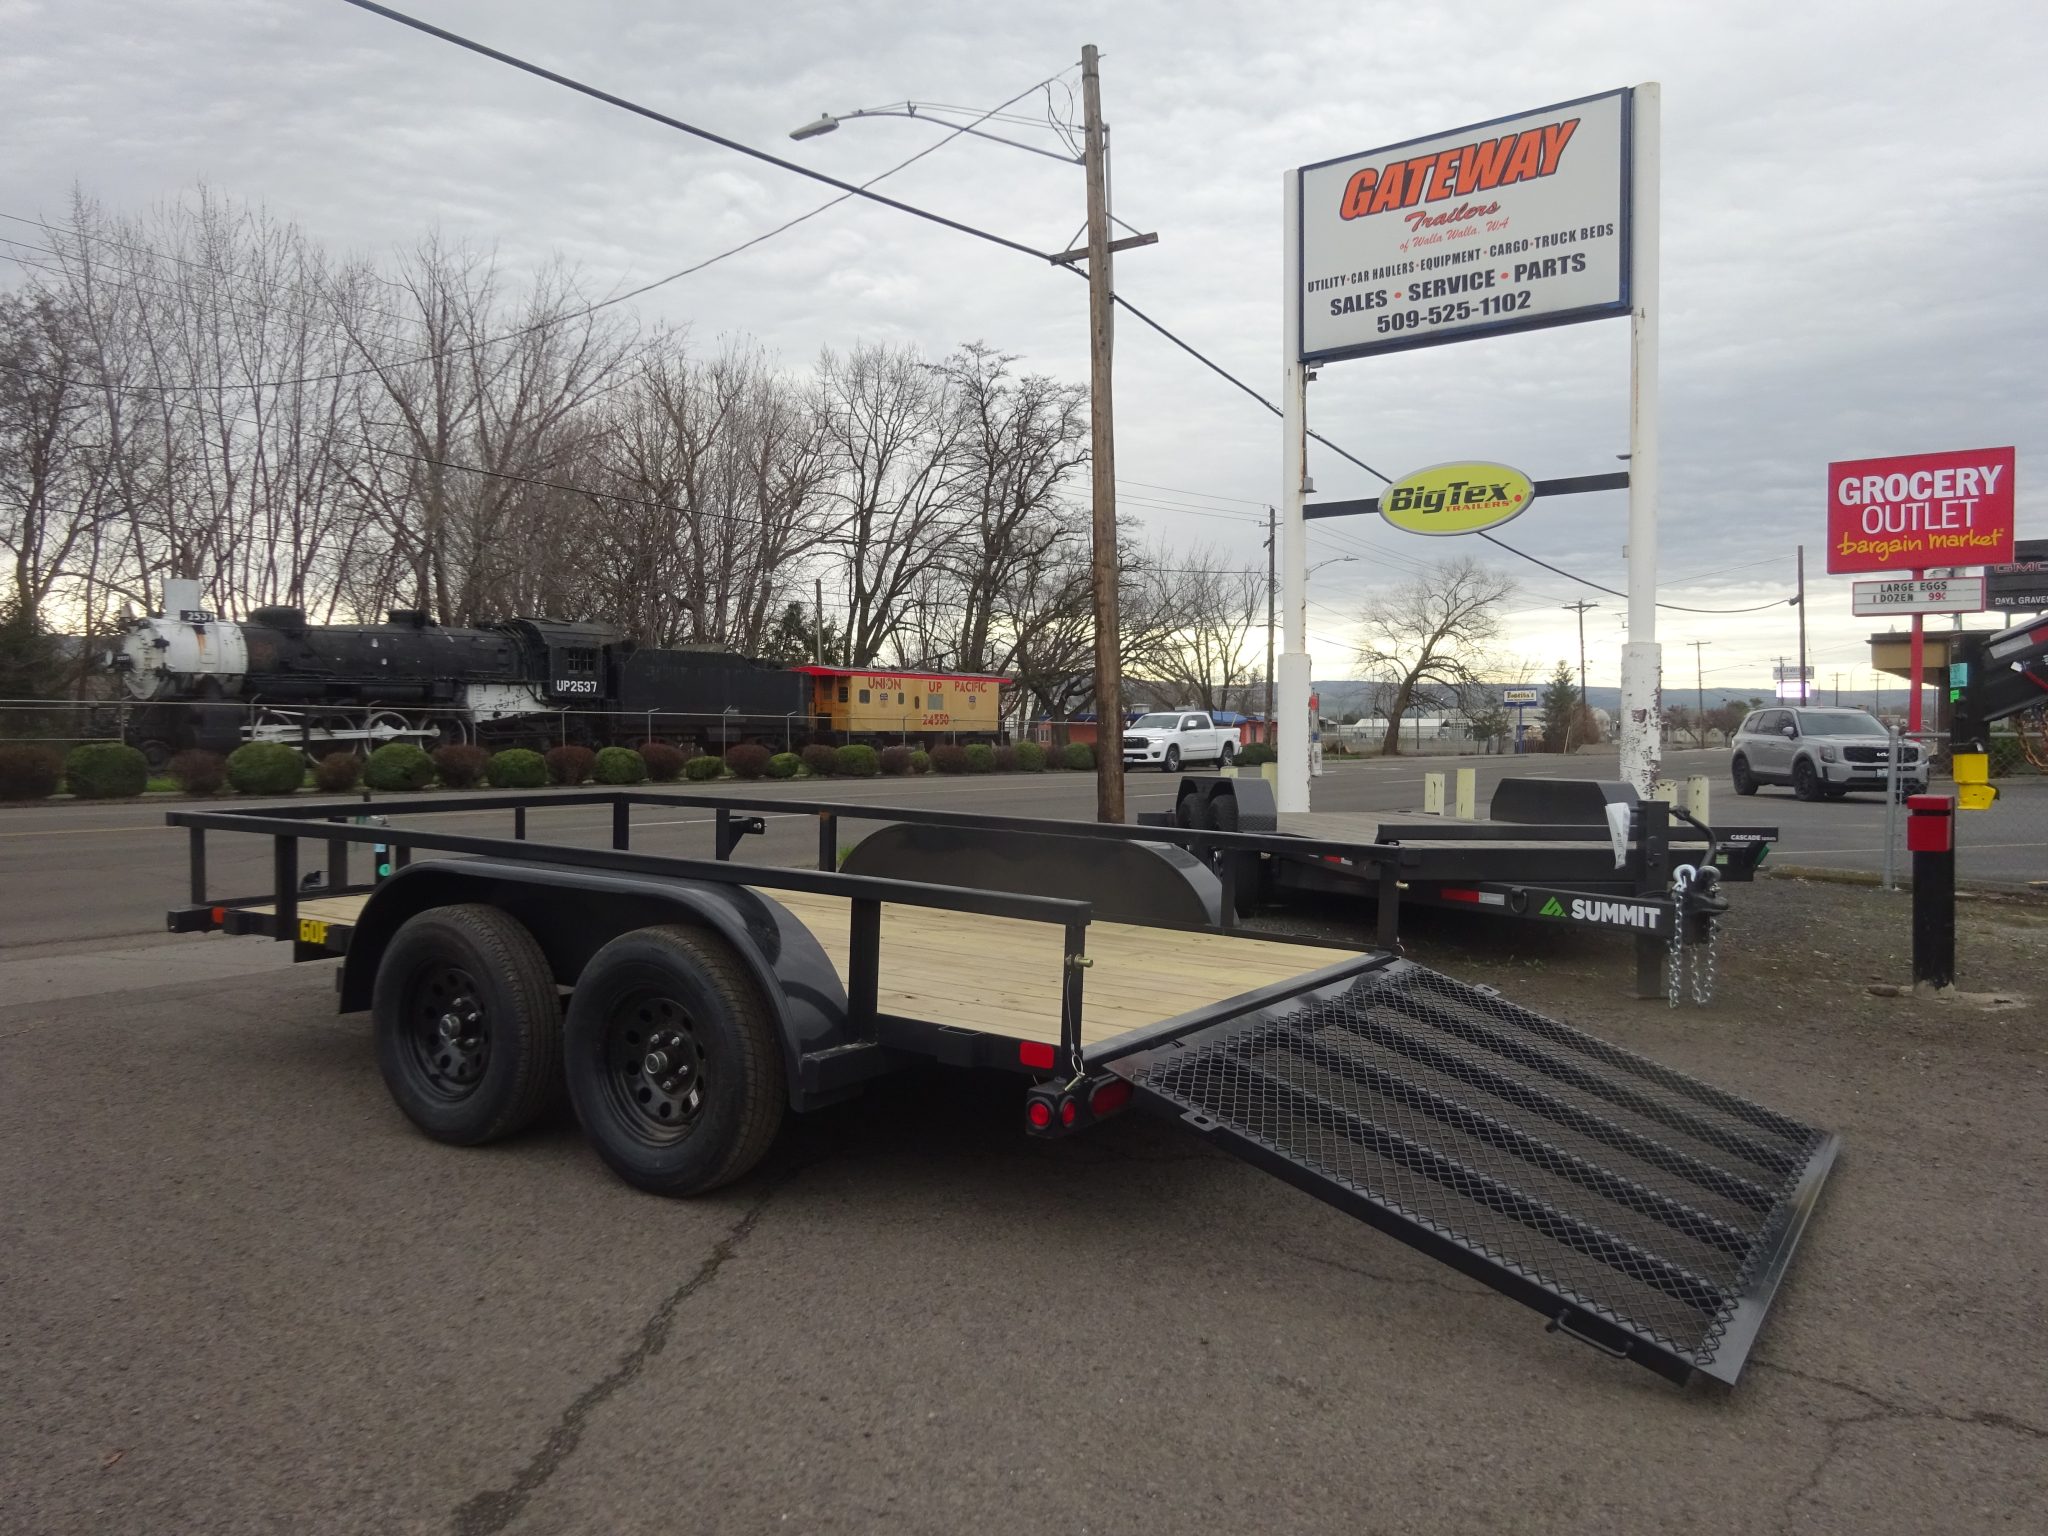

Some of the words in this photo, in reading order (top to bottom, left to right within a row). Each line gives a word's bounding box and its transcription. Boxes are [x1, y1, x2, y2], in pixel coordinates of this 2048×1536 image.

[1339, 118, 1581, 221] GATEWAY
[1404, 201, 1501, 232] Trailers
[1307, 274, 1347, 293] UTILITY
[1351, 270, 1369, 284] CAR
[1372, 261, 1414, 280] HAULERS
[1420, 248, 1481, 271] EQUIPMENT
[1489, 239, 1529, 257] CARGO
[1534, 229, 1577, 249] TRUCK
[1580, 223, 1614, 241] BEDS
[1400, 239, 1409, 253] of
[1412, 232, 1443, 247] Walla
[1330, 289, 1388, 316] SALES
[1408, 269, 1495, 301] SERVICE
[1514, 253, 1586, 283] PARTS
[1377, 290, 1531, 333] 509-525-1102
[1838, 465, 2003, 506] GROCERY
[1444, 501, 1510, 512] TRAILERS
[1862, 498, 1979, 534] OUTLET
[1837, 532, 1922, 561] bargain
[1928, 528, 2003, 548] market
[1880, 583, 1914, 593] LARGE
[1920, 581, 1947, 591] EGGS
[1880, 593, 1914, 603] DOZEN
[1995, 597, 2015, 605] DAYL
[556, 680, 597, 692] UP2537
[868, 678, 902, 690] UNION
[928, 681, 942, 693] UP
[954, 681, 987, 693] PACIFIC
[922, 714, 949, 725] 24550
[1571, 898, 1661, 929] SUMMIT
